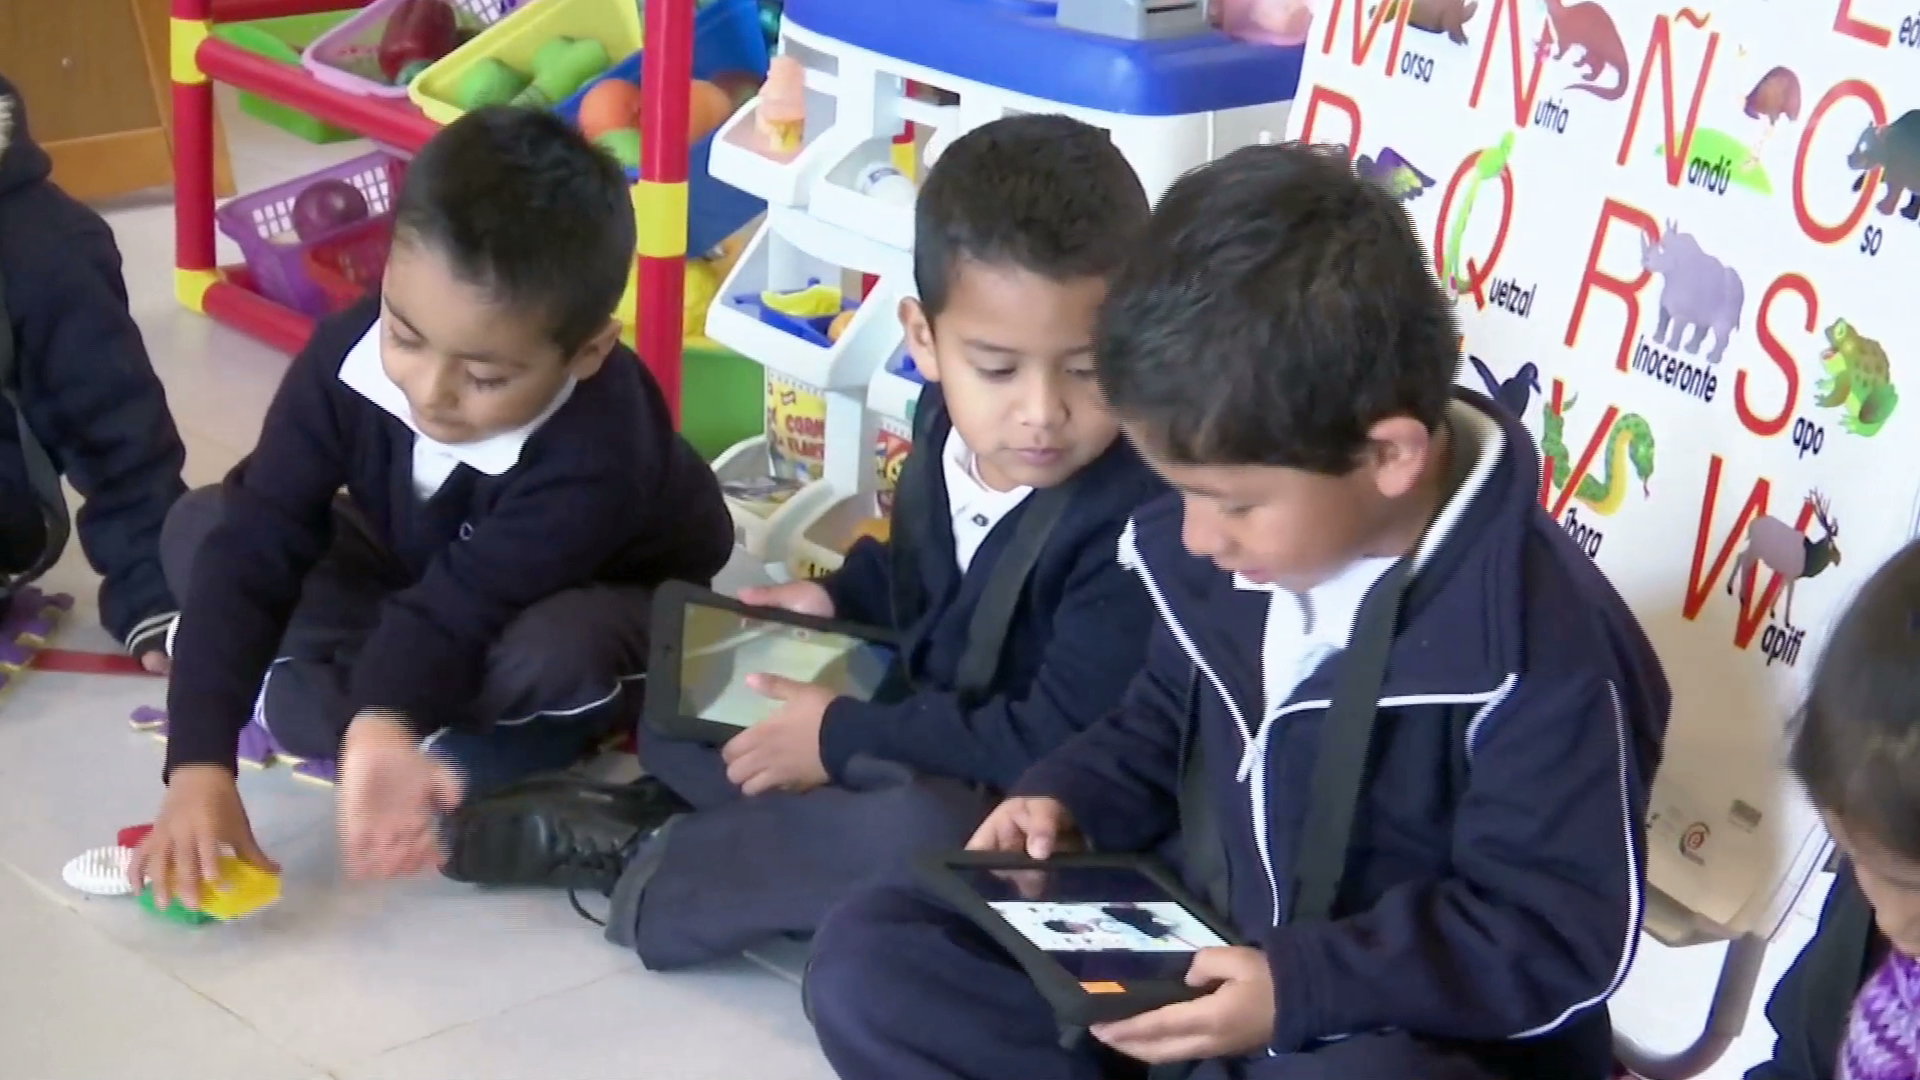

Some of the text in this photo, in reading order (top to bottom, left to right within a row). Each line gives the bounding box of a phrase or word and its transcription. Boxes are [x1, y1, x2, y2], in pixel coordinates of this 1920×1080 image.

[1401, 51, 1435, 83] orsa
[1468, 0, 1569, 134] N utria
[1616, 7, 1732, 196] Ñ andú
[1434, 149, 1537, 319] Q uetzal
[1792, 79, 1889, 245] O
[1860, 224, 1883, 256] so
[1564, 198, 1718, 403] R inoceronte
[1734, 272, 1825, 460] S apo
[1682, 453, 1817, 651] W
